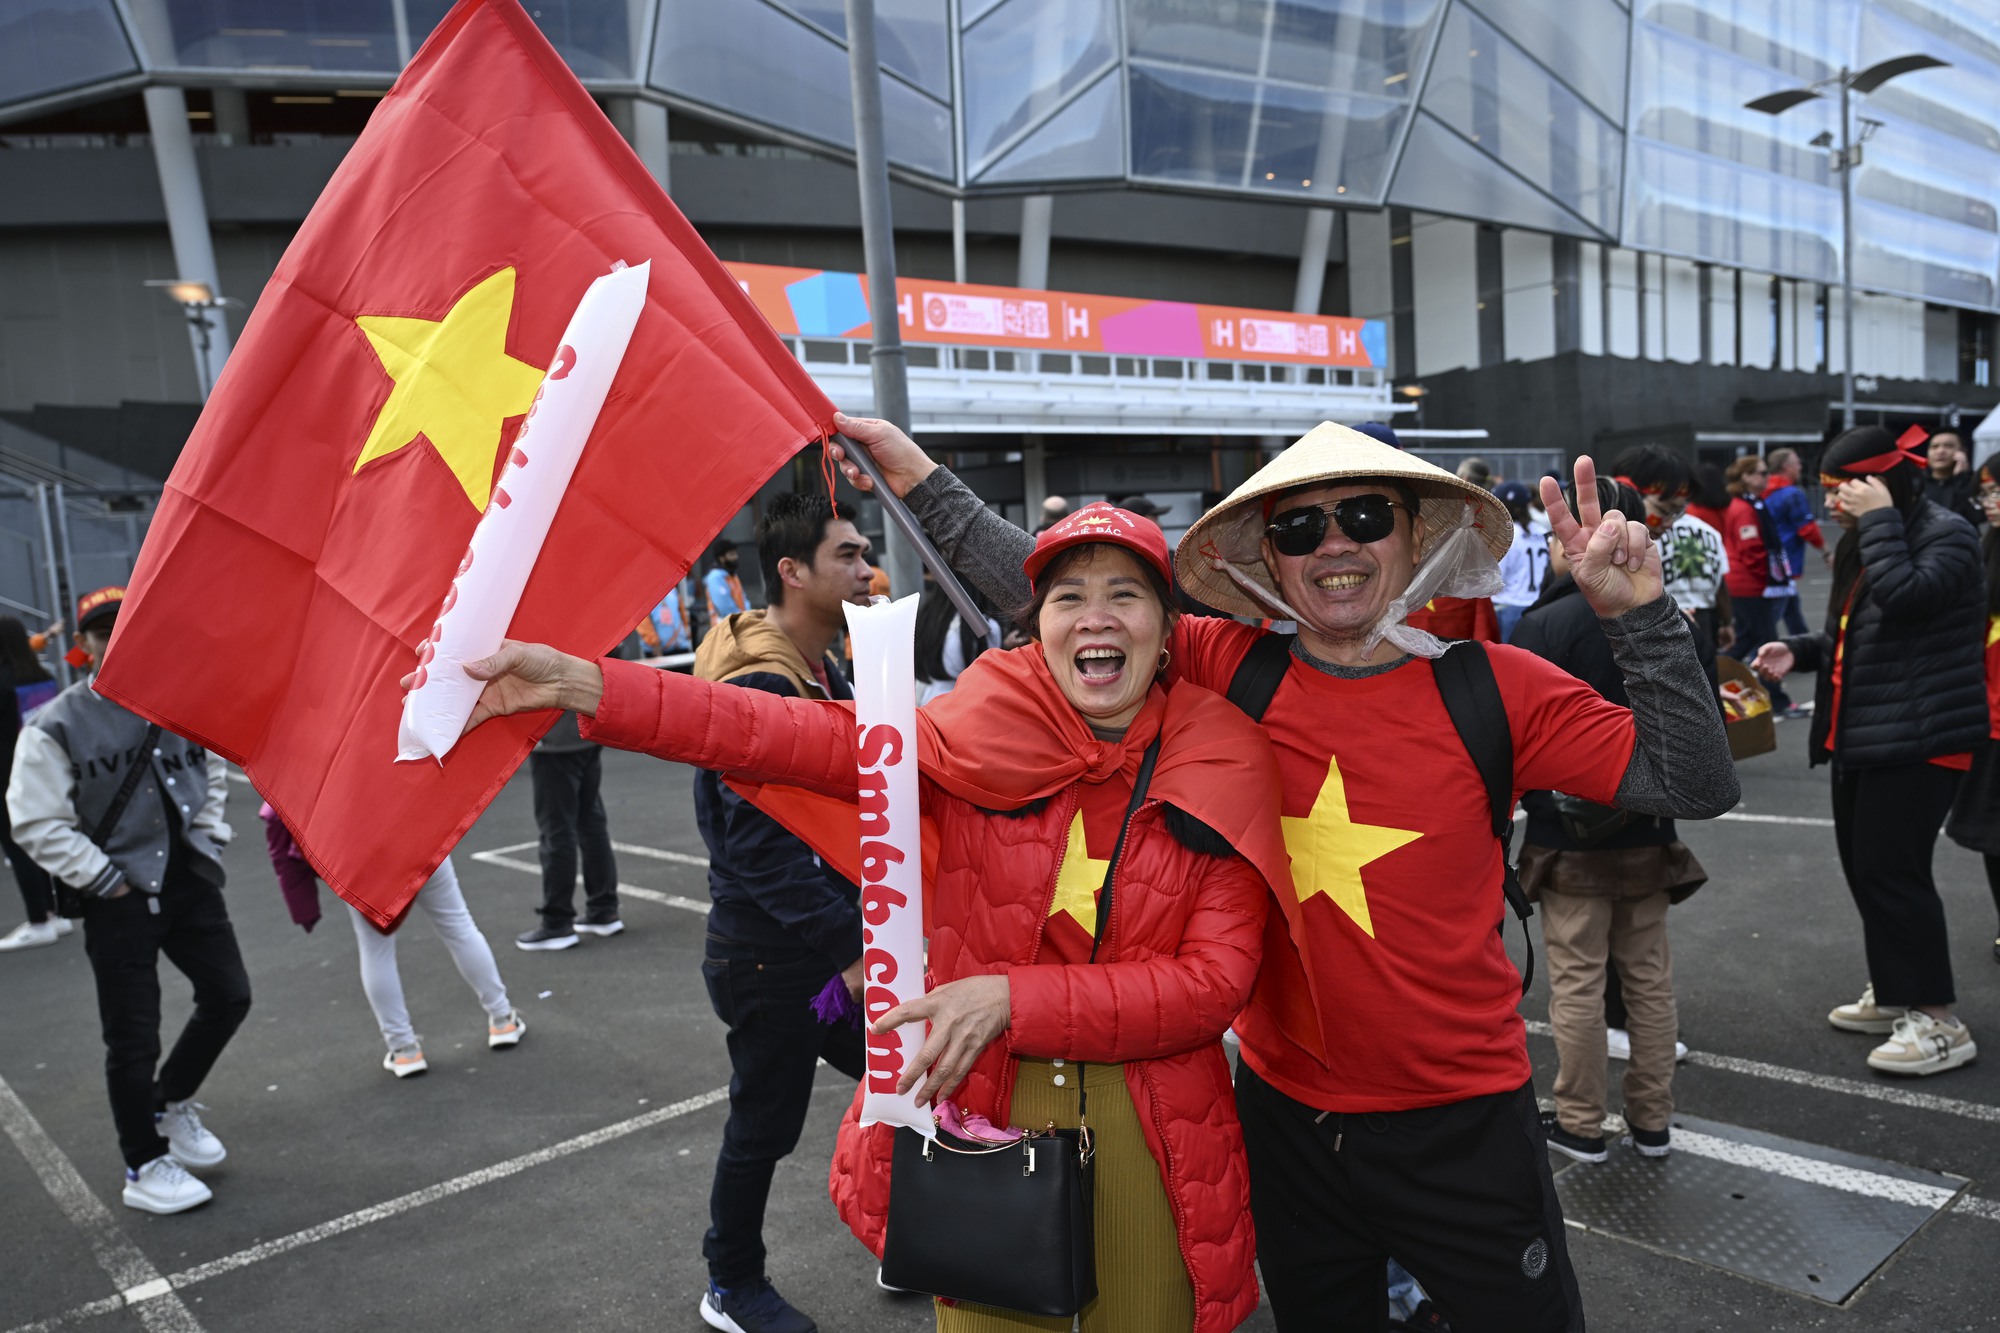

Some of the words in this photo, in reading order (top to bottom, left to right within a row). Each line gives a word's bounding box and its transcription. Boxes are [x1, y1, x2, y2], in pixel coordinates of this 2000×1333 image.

[1068, 307, 1089, 338] H
[1215, 319, 1234, 348] H
[1339, 329, 1356, 356] H
[1096, 525, 1122, 536] BÁC
